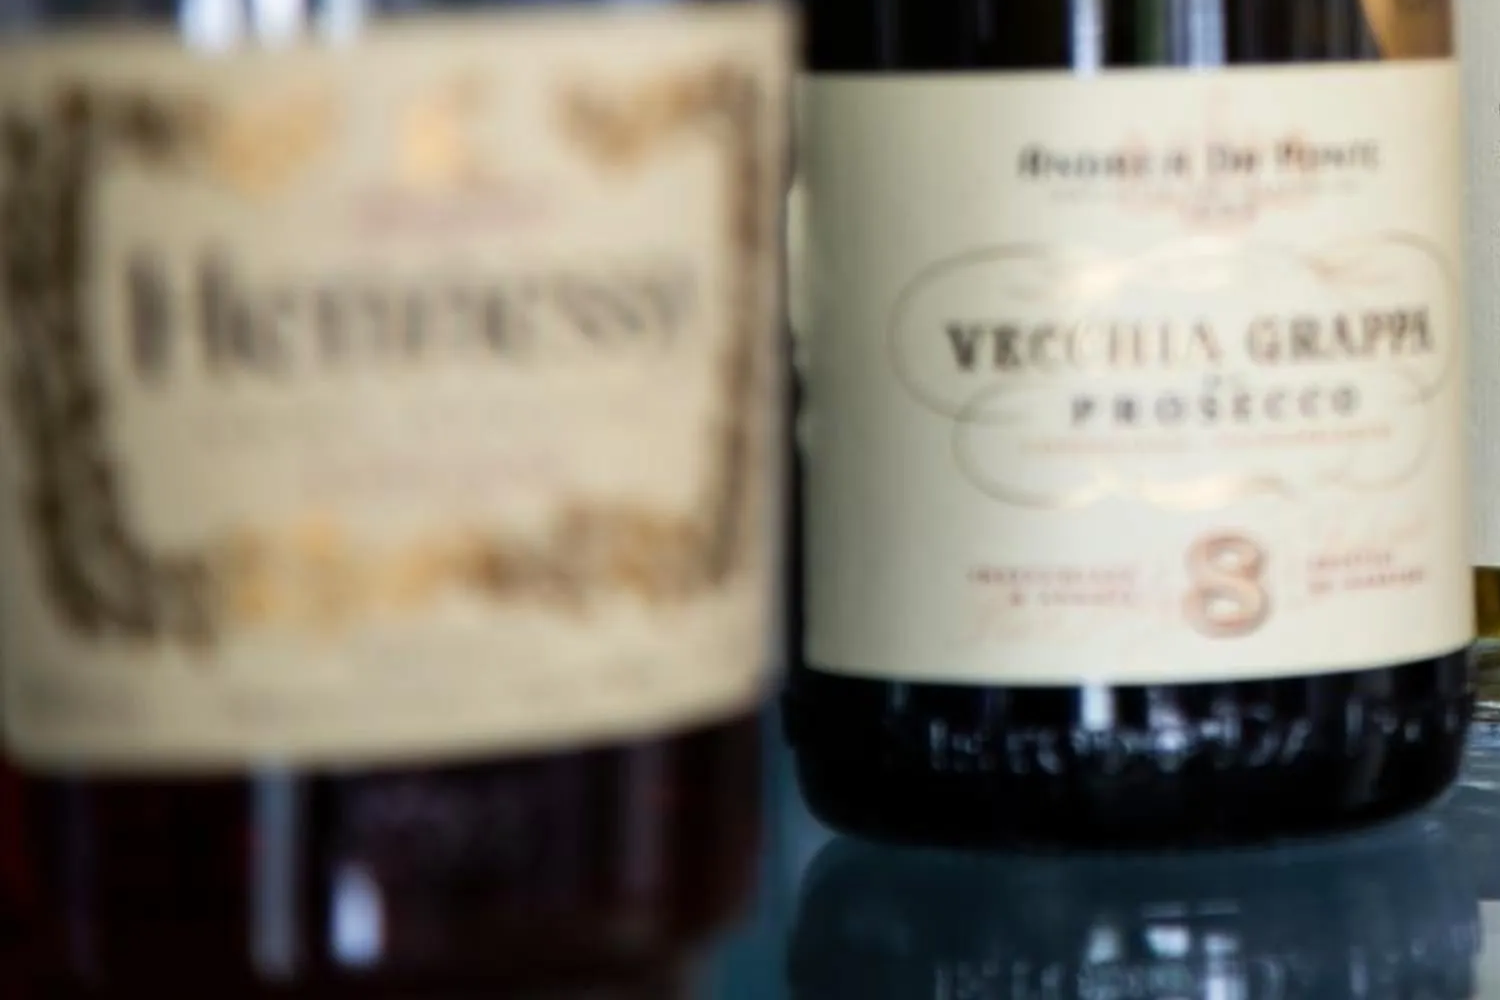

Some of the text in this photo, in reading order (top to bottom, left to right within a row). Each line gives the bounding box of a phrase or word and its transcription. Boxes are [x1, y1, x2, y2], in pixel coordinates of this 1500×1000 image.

[1244, 306, 1435, 364] GRAPPA
[1071, 386, 1360, 428] PROSECCO
[1183, 528, 1272, 637] 8
